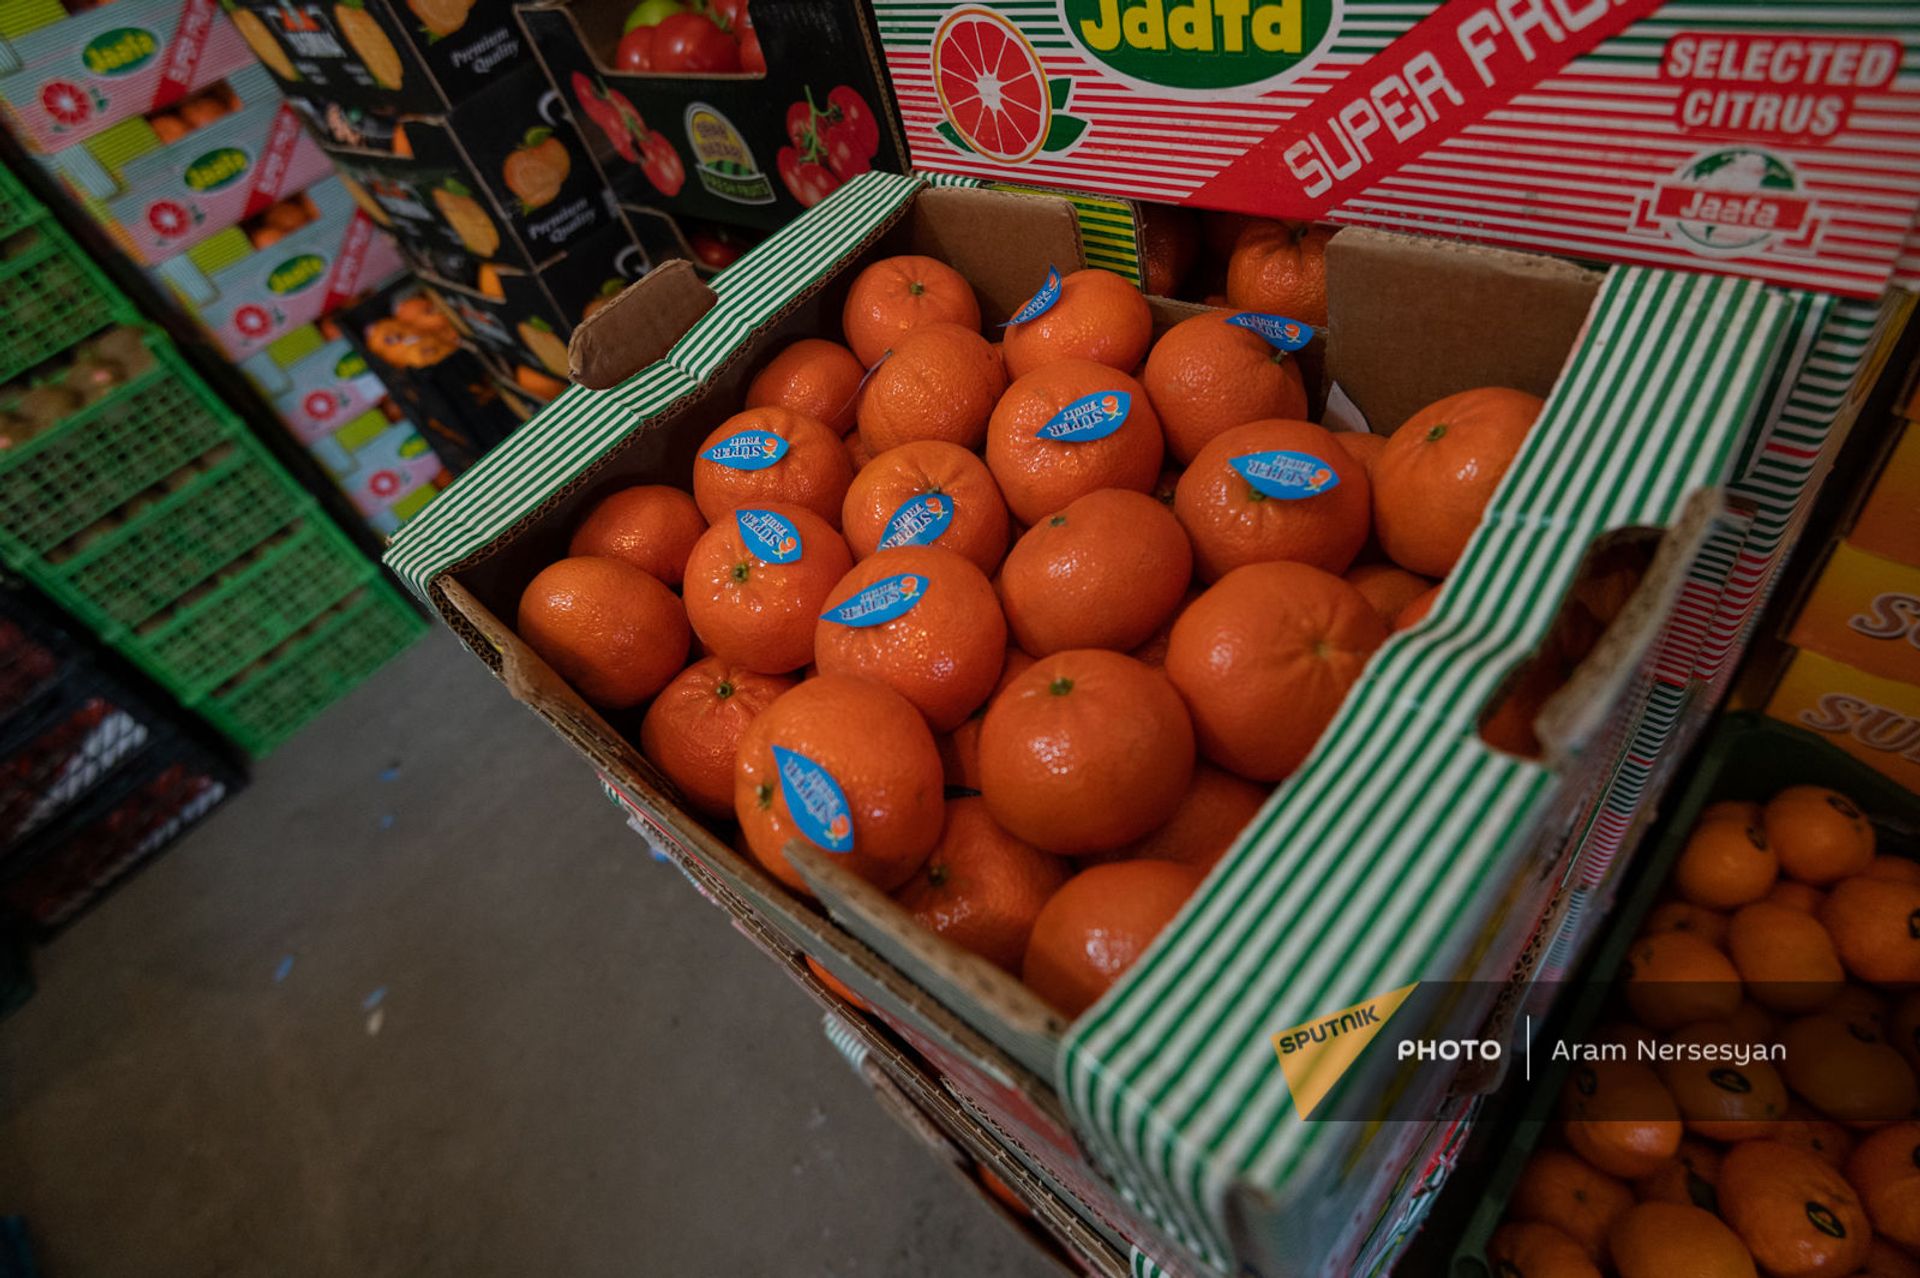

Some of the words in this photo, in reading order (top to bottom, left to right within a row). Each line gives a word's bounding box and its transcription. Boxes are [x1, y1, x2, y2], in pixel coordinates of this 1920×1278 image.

[451, 28, 509, 67] Premium
[472, 40, 519, 73] Quality
[1667, 39, 1894, 87] SELECTED
[1283, 51, 1465, 199] SUPER
[1682, 91, 1845, 136] CITRUS
[528, 198, 588, 240] Premium
[1680, 191, 1780, 229] Jaafa
[1849, 592, 1920, 648] S
[1798, 692, 1920, 763] SU
